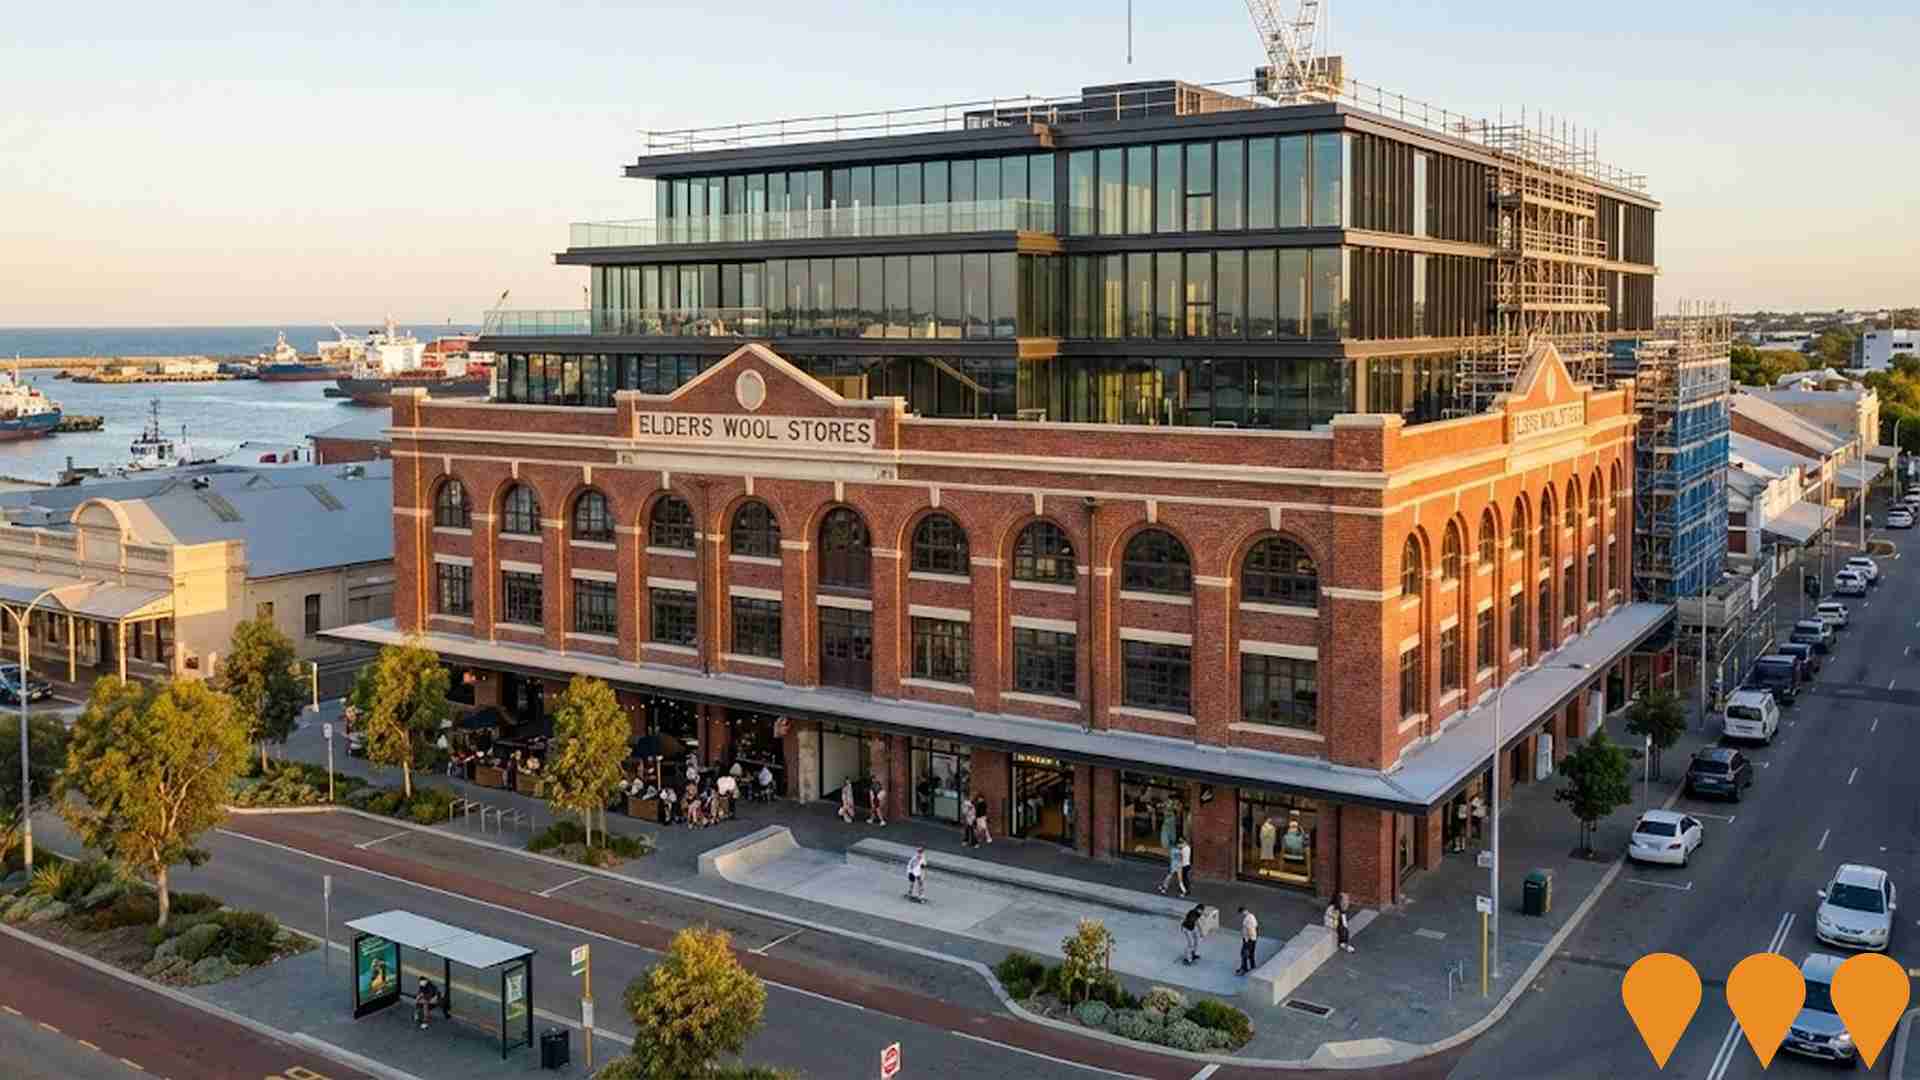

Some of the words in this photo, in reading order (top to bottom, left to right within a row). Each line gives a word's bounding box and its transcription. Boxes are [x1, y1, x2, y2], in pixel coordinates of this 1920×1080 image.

[639, 415, 713, 437] ELDERS
[723, 417, 778, 440] WOOL
[787, 420, 872, 443] STORES
